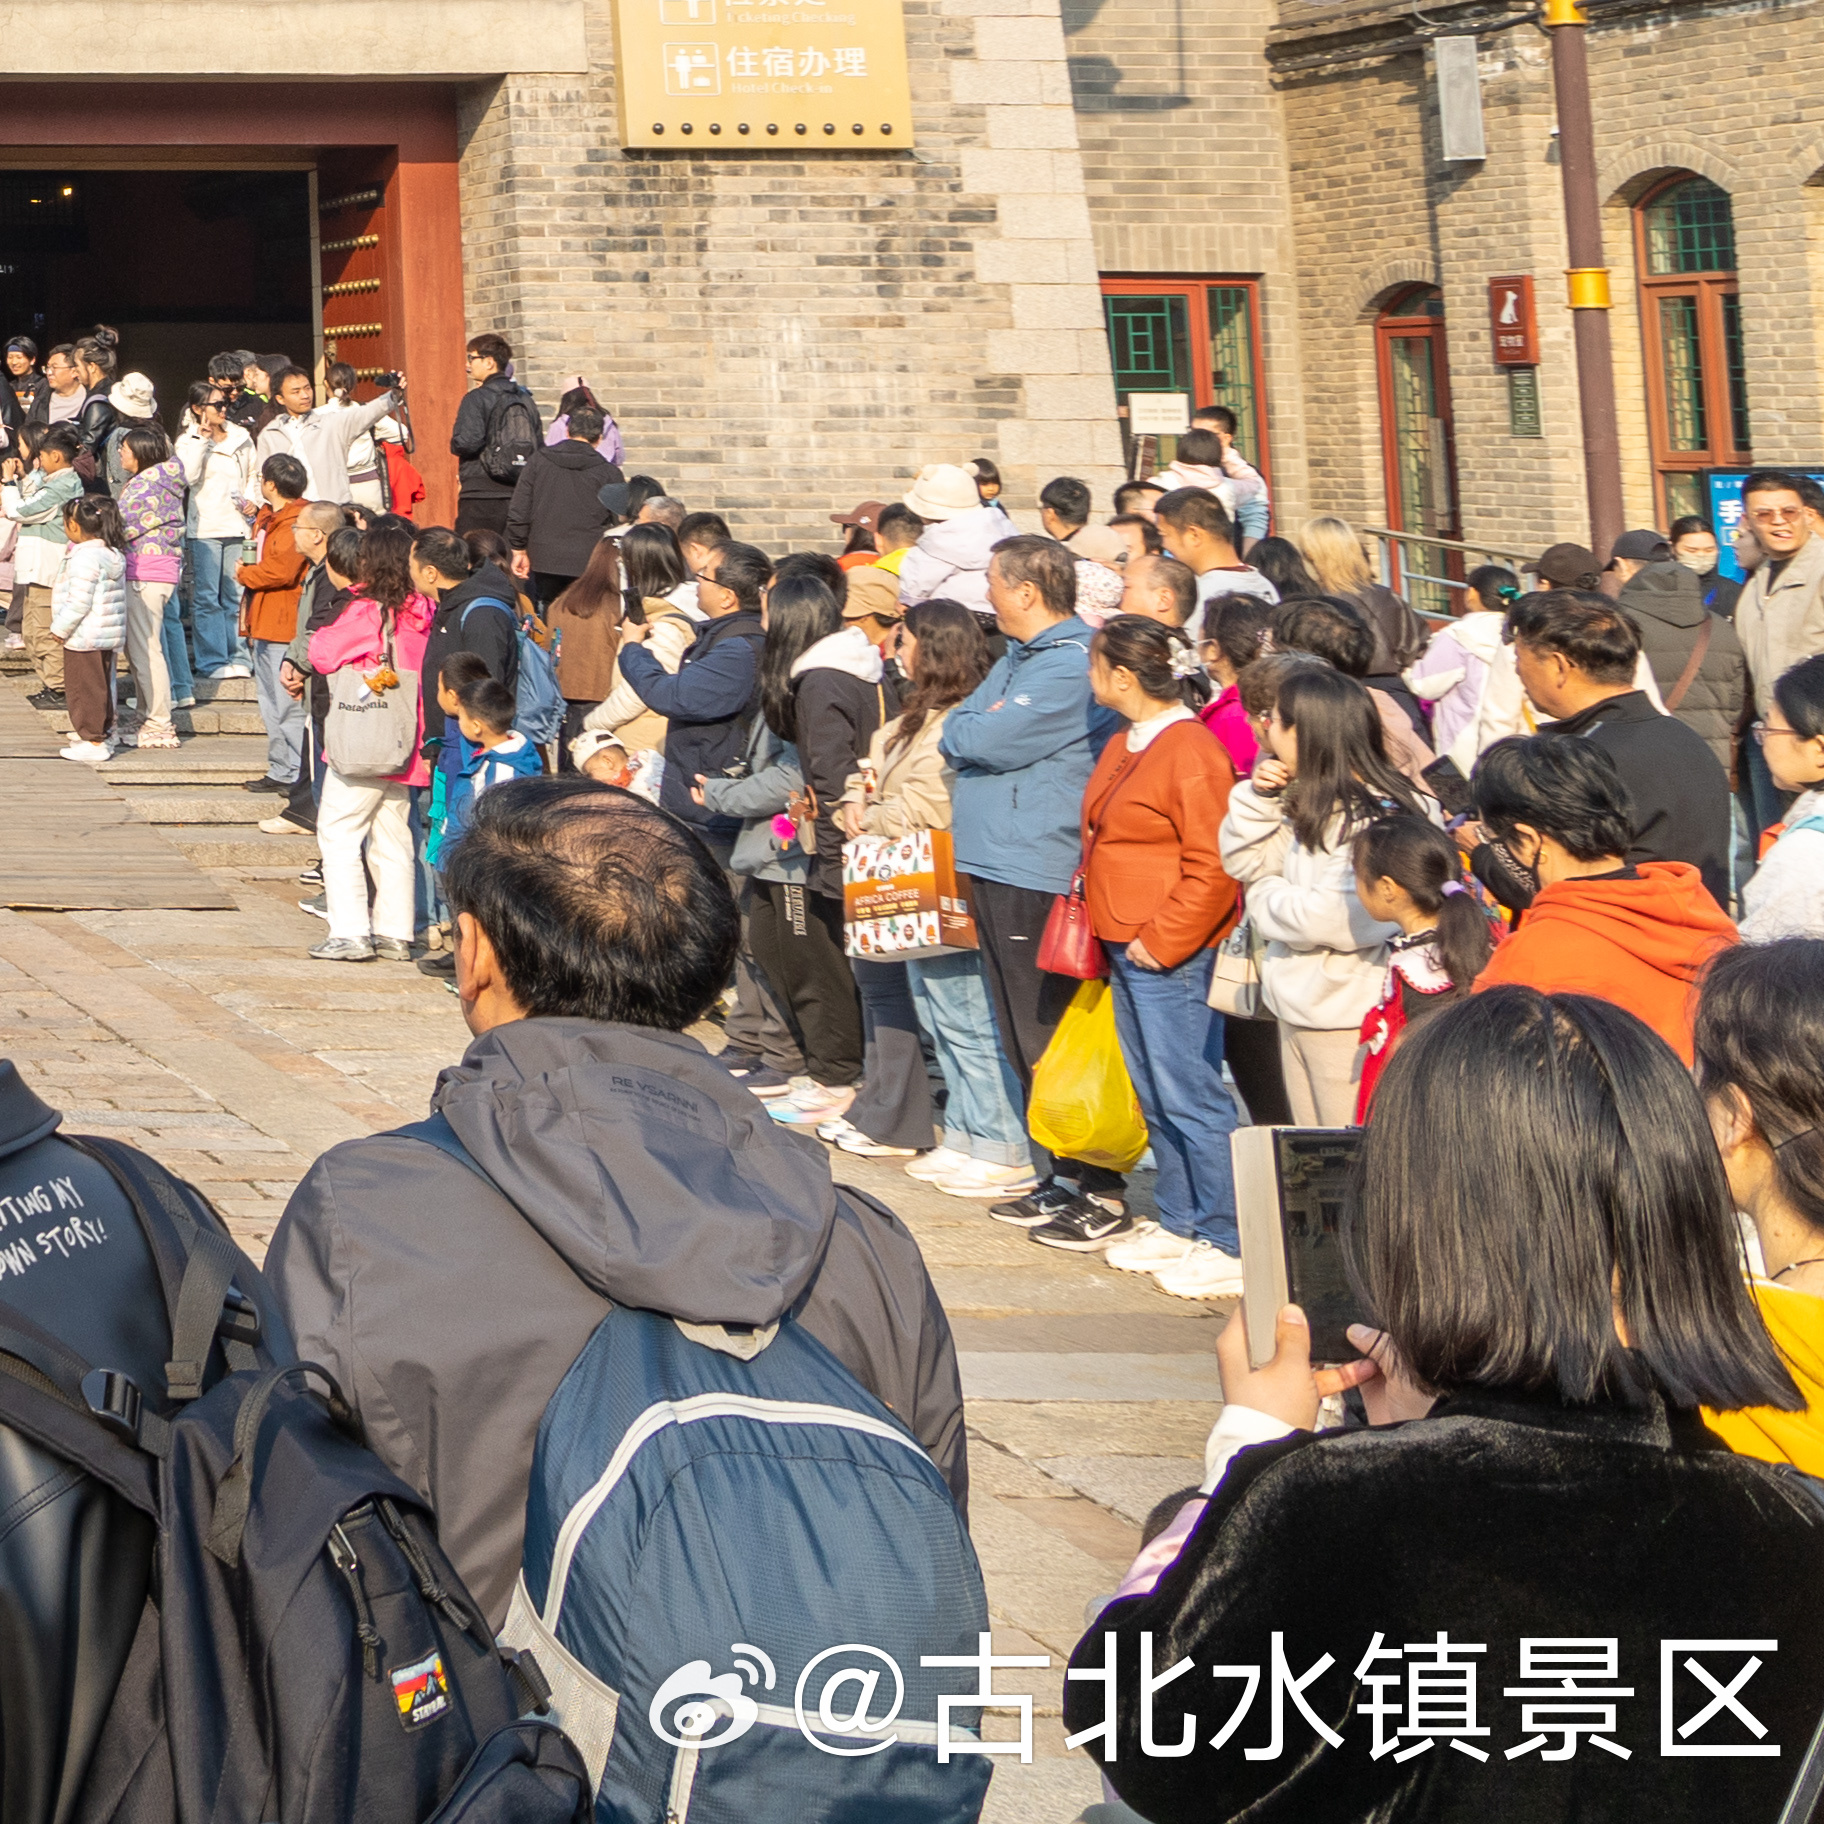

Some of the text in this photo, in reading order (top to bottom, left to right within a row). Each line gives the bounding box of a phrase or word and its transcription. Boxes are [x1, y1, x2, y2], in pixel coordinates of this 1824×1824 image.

[726, 46, 869, 77] 住宿办理
[855, 888, 920, 906] AFRICA COFFEE
[49, 1176, 84, 1209] MY
[36, 1216, 108, 1258] STORY!
